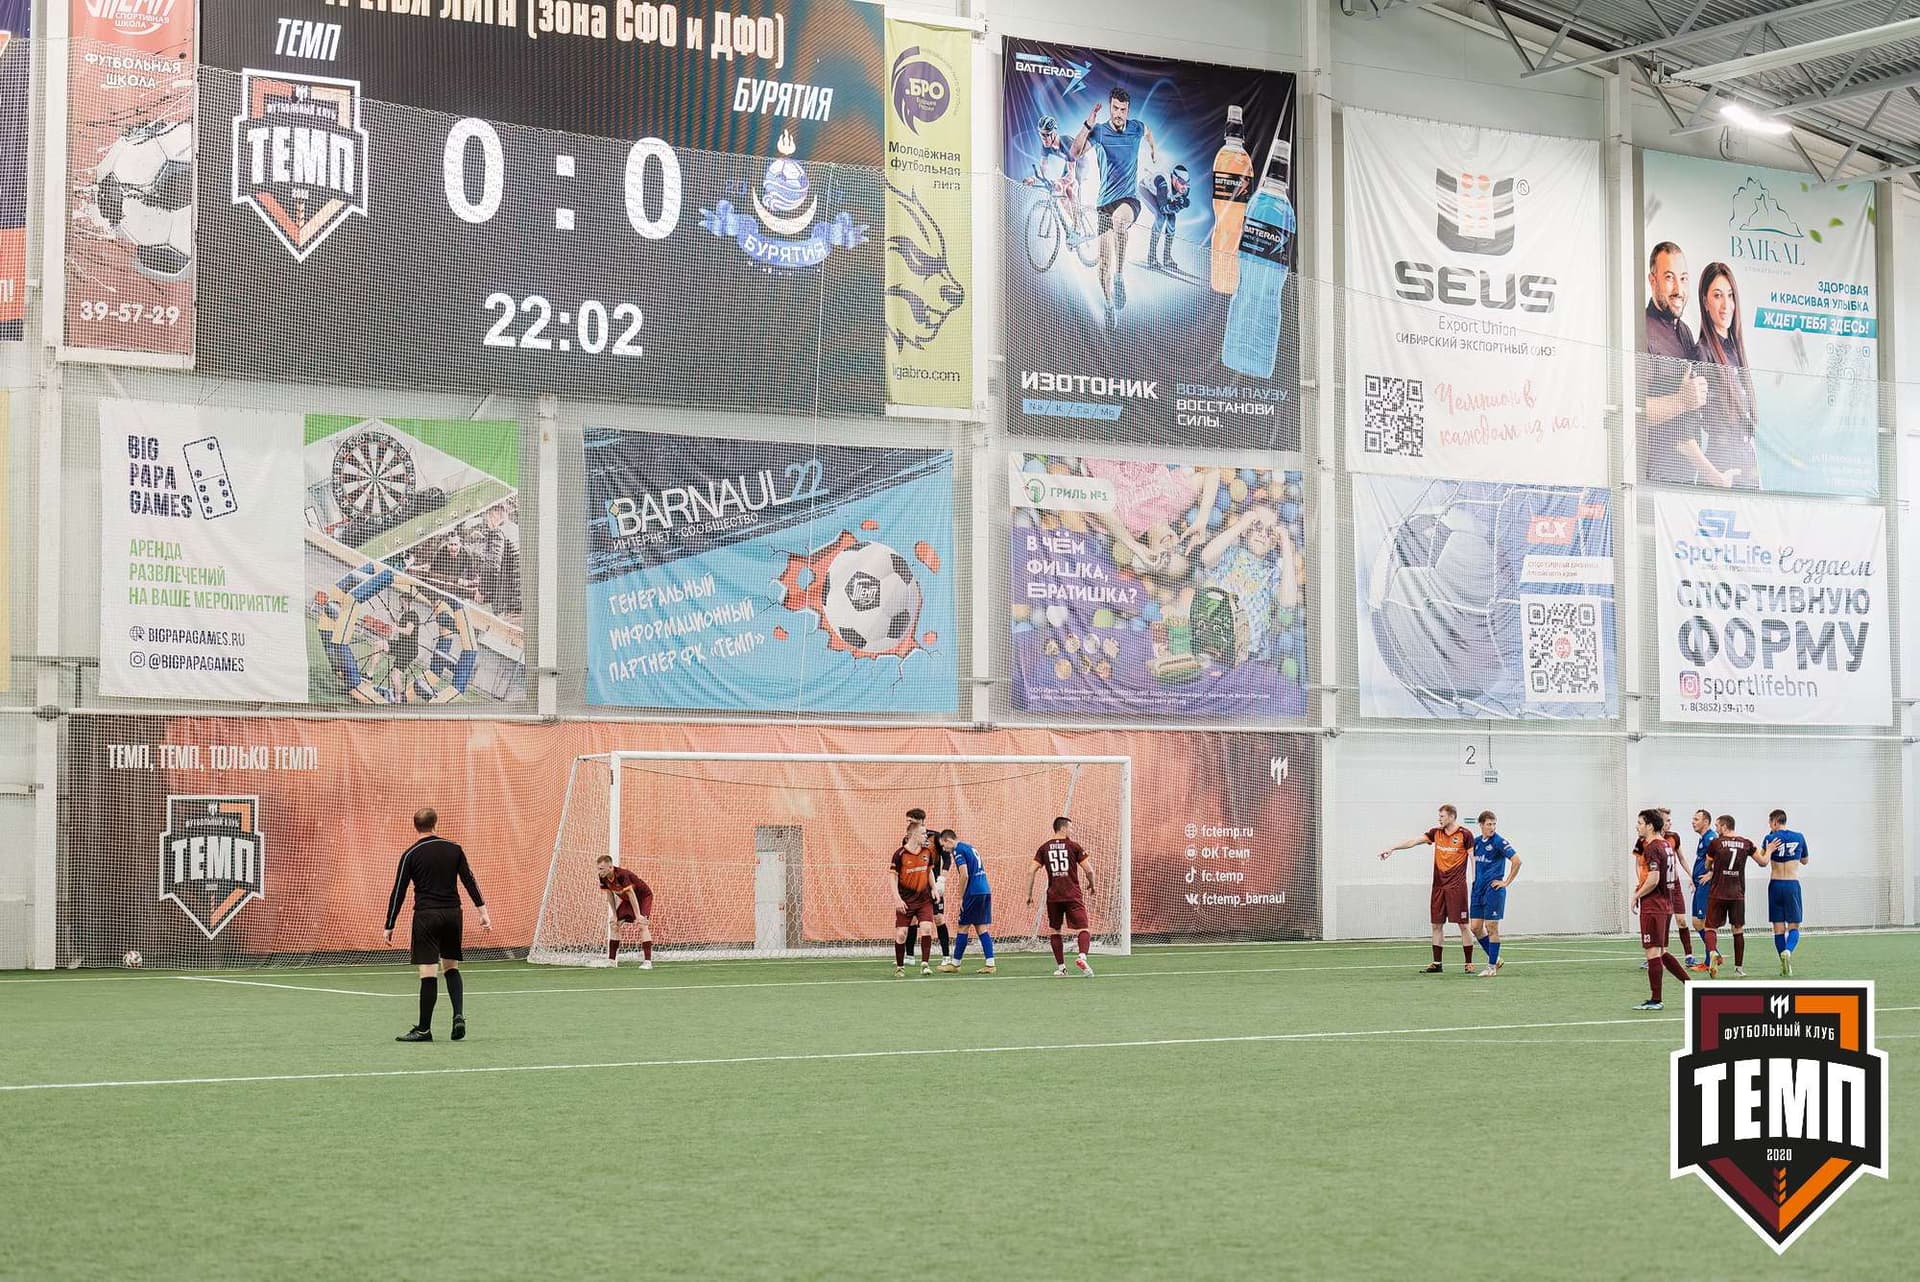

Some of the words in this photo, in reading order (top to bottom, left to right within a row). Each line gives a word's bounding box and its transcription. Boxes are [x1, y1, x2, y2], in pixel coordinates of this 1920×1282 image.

[115, 12, 169, 24] СПОРТИВНАЯ
[115, 20, 147, 28] ШКОЛА
[275, 18, 342, 61] ТЕМП
[616, 0, 678, 44] СФО
[686, 17, 702, 50] и
[711, 11, 784, 69] ДФО)
[85, 53, 181, 73] ФУТБОЛЬНАЯ
[1015, 61, 1082, 78] BATTERADE
[106, 73, 156, 88] ШКОЛА
[733, 76, 834, 122] БУРЯТИЯ
[247, 126, 355, 196] ТЕМП
[888, 141, 961, 162] Молодёжная
[890, 156, 961, 177] футбольная
[443, 117, 504, 224] 0
[625, 136, 683, 240] 0
[743, 233, 828, 263] БУРЯТИЯ
[1731, 236, 1806, 266] BAIKAL
[1395, 260, 1557, 313] SEUS
[1818, 281, 1869, 296] ЗДОРОВАЯ
[80, 301, 180, 325] 39-57-29
[1770, 292, 1777, 302] И
[1780, 293, 1830, 308] КРАСИВАЯ
[1832, 299, 1869, 312] УЛЫБКА
[483, 293, 645, 357] 22:02
[1438, 315, 1479, 334] Export
[1482, 320, 1517, 337] Union
[1763, 311, 1798, 329] ЖДЕТ
[1800, 316, 1827, 331] ТЕБЯ
[1829, 319, 1869, 335] ЗДЕСЬ!
[1395, 332, 1457, 349] СИБИРСКИЙ
[1460, 339, 1528, 355] ЭКСПОРТНЫЙ
[1021, 371, 1159, 400] ИЗОТОНИК
[1176, 383, 1238, 397] ВОЗЬМИ
[1176, 399, 1275, 415] ВОССТАНОВИ
[1177, 414, 1224, 428] СИЛЫ.
[128, 434, 159, 461] BIG
[129, 462, 177, 490] PAPA
[129, 489, 193, 519] GAMES
[1050, 487, 1087, 500] ГРИЛЬ
[129, 538, 182, 560] АРЕНДА
[1026, 535, 1037, 551] В
[1046, 531, 1085, 555] ЧЁМ
[1674, 541, 1772, 566] SportLife
[129, 563, 226, 586] РАЗВЛЕЧЕНИЙ
[1026, 560, 1109, 584] ФИШКА,
[129, 587, 148, 605] НА
[151, 587, 191, 608] ВАШЕ
[194, 590, 289, 613] МЕРОПРИЯТИЕ
[608, 571, 716, 615] ГЕНЕРАЛЬНЫЙ
[1026, 582, 1138, 604] БРАТИШКА?
[1677, 579, 1871, 615] СПОРТИВНУЮ
[609, 596, 755, 650] ИНФОРМАЦИОННЫЙ
[148, 627, 246, 646] BIGPAPAGAMES.RU
[1677, 615, 1870, 673] ФОРМУ
[149, 653, 245, 672] @BIGPAPAGAMES
[609, 650, 677, 683] ПАРТНЕР
[680, 643, 707, 667] ФК
[711, 631, 765, 658] «ТЕМП»
[1703, 674, 1818, 700] sportlifebrn
[107, 744, 154, 772] ТЕМП,
[159, 744, 204, 772] ТЕМП,
[209, 745, 268, 770] ТОЛЬКО
[274, 746, 318, 770] ТЕМП!
[1465, 745, 1476, 765] 2
[1201, 824, 1254, 839] fctemp.ru
[171, 835, 255, 885] ТЕМП
[1048, 849, 1069, 872] 55
[1201, 847, 1219, 860] ФК
[1221, 846, 1251, 860] Темп
[1728, 847, 1738, 870] 7
[1201, 870, 1244, 884] fc.temp
[1202, 891, 1286, 908] fctemp_barnaul
